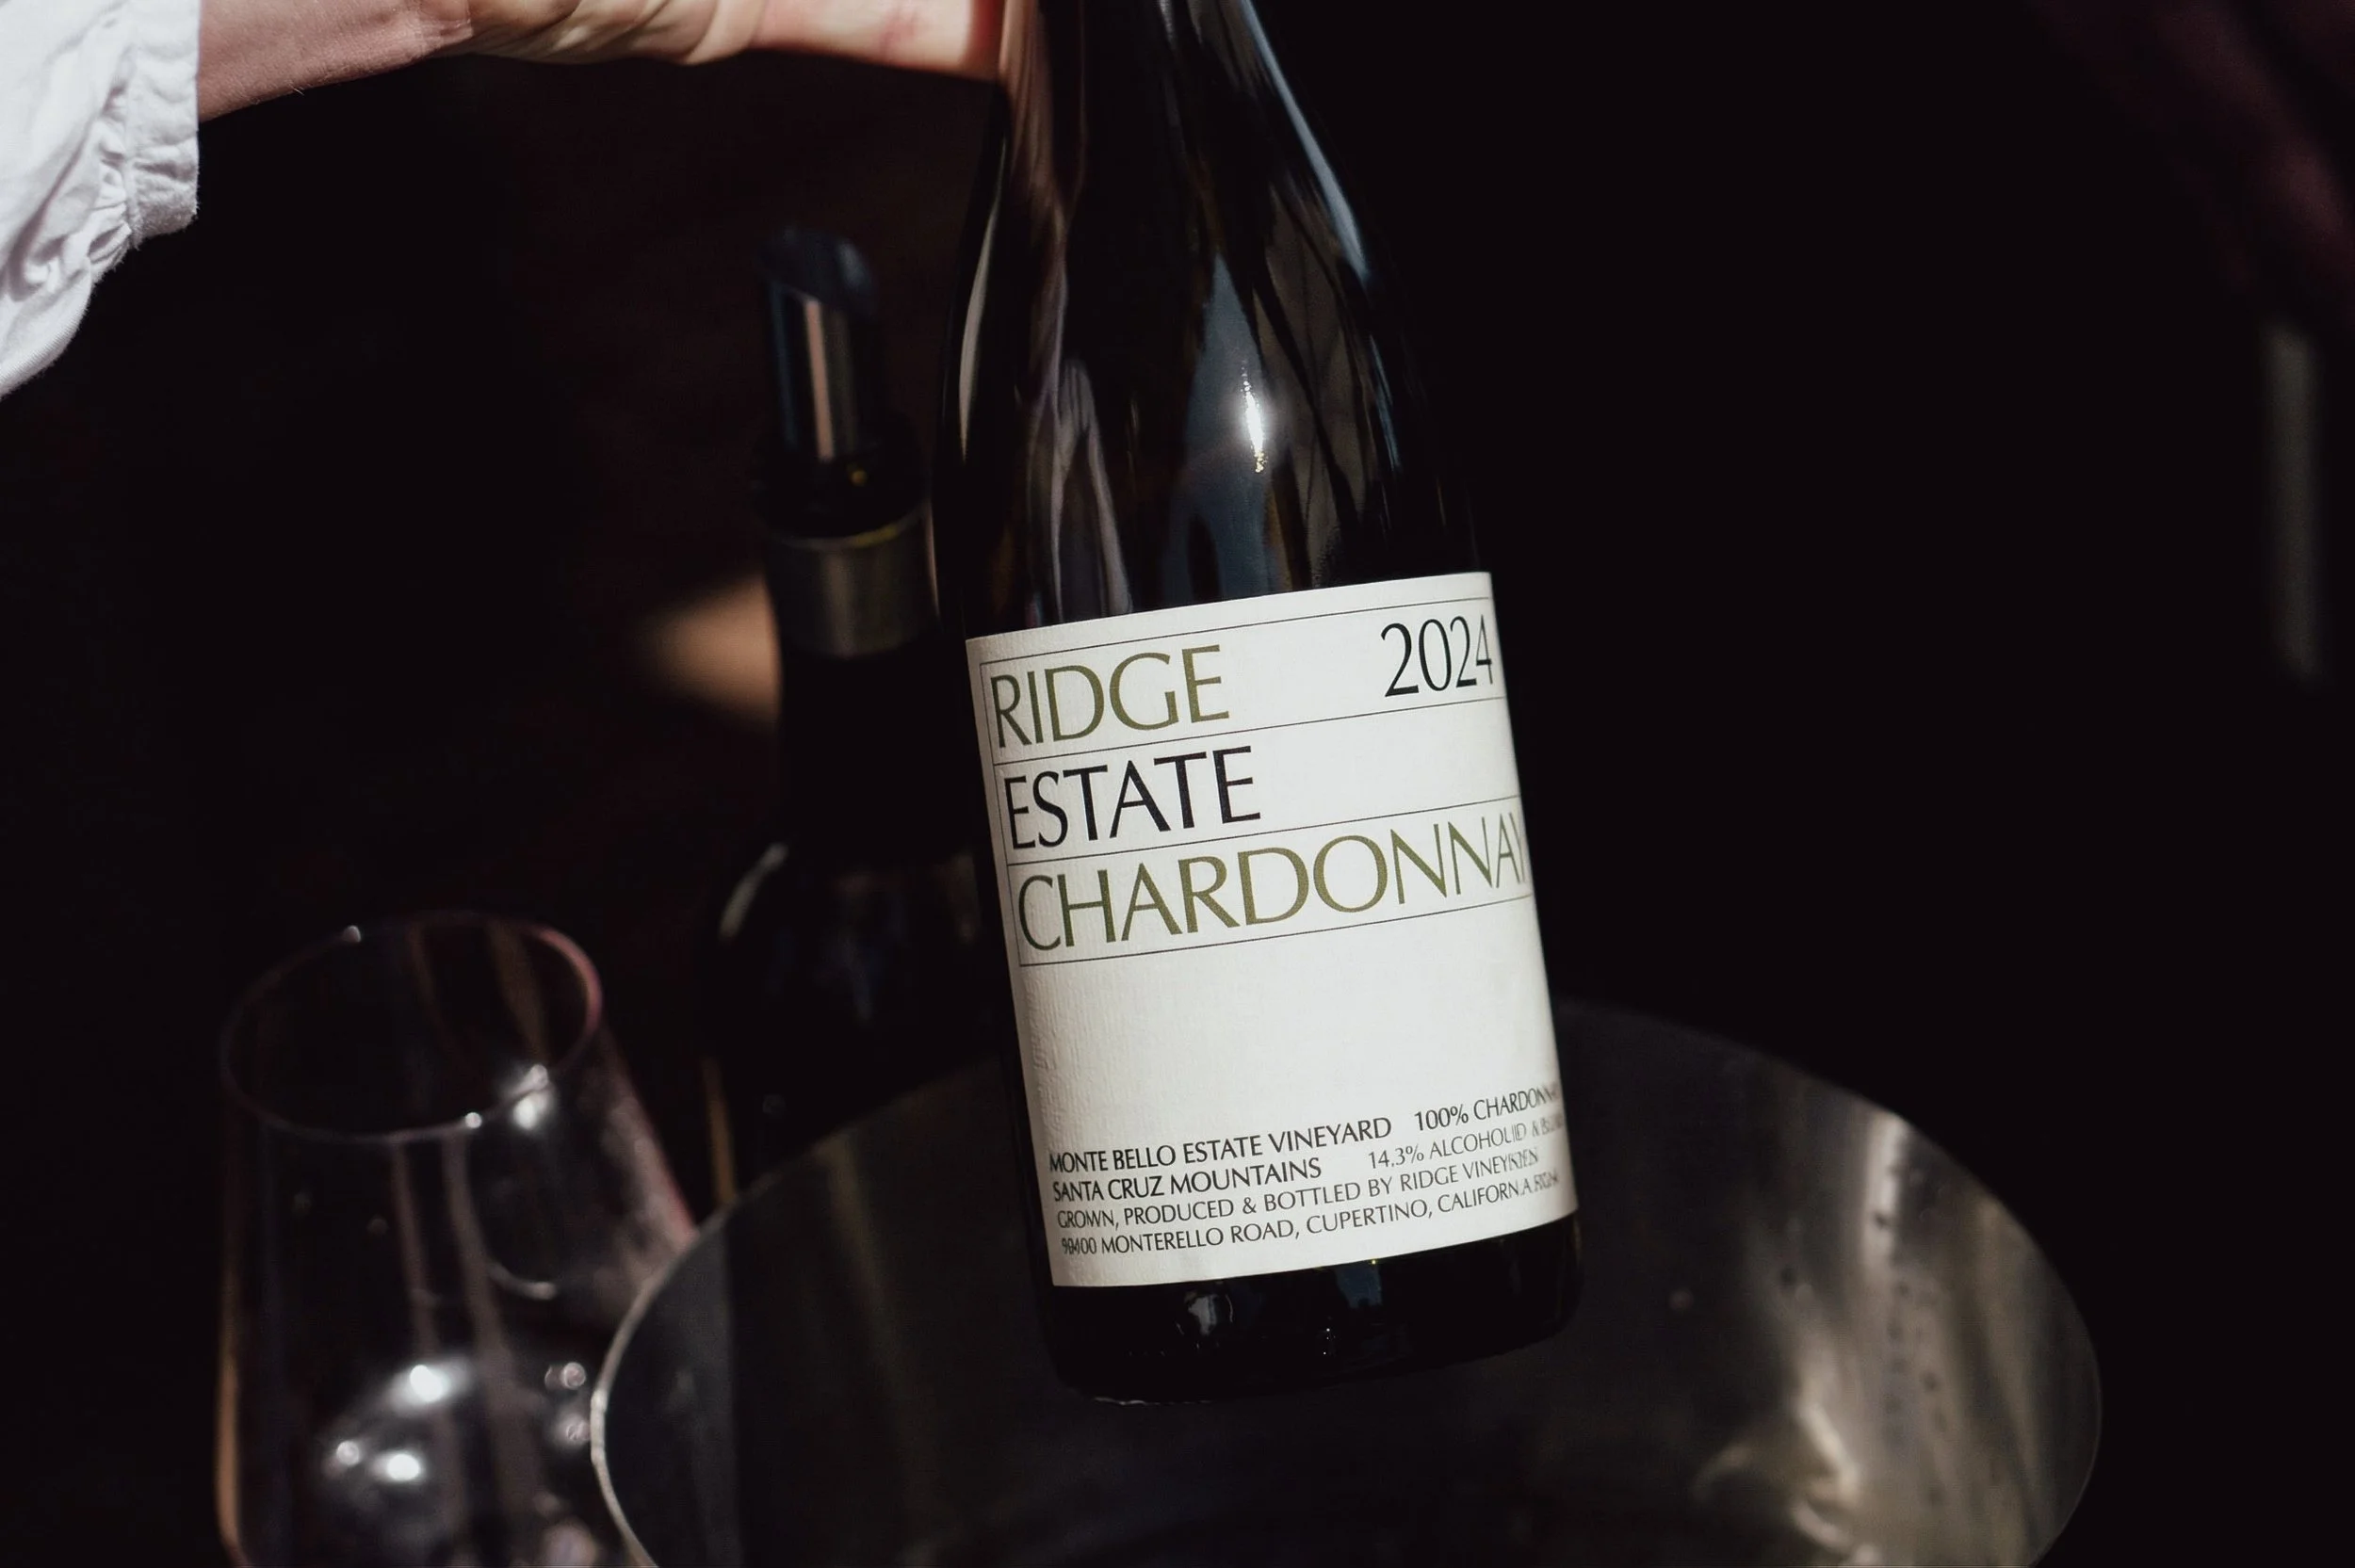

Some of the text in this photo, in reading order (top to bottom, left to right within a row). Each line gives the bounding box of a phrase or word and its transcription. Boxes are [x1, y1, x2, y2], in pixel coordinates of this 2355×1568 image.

[1380, 614, 1493, 697] 2024
[989, 644, 1230, 748] RIDGE
[1003, 745, 1262, 850] ESTATE
[1049, 1151, 1109, 1173] MONTE
[1113, 1145, 1177, 1171] BELLO
[1183, 1135, 1264, 1165] ESTATE
[1268, 1117, 1392, 1154] VINEYARD
[1414, 1104, 1470, 1132] 100%
[1052, 1180, 1105, 1203] SANTA
[1107, 1175, 1166, 1201] CRUZ
[1170, 1157, 1323, 1196] MOUNTAINS
[1368, 1145, 1425, 1170] 14.3%
[1057, 1208, 1120, 1232] GROWN,
[1124, 1200, 1235, 1226] PRODUCED
[1242, 1196, 1258, 1215] &
[1263, 1183, 1361, 1213] BOTTLED
[1368, 1176, 1393, 1198] BY
[1399, 1165, 1459, 1192] RIDGE
[1100, 1227, 1225, 1254] MONTERELLO
[1229, 1220, 1300, 1244] ROAD,
[1306, 1202, 1433, 1235] CUPERTINO,
